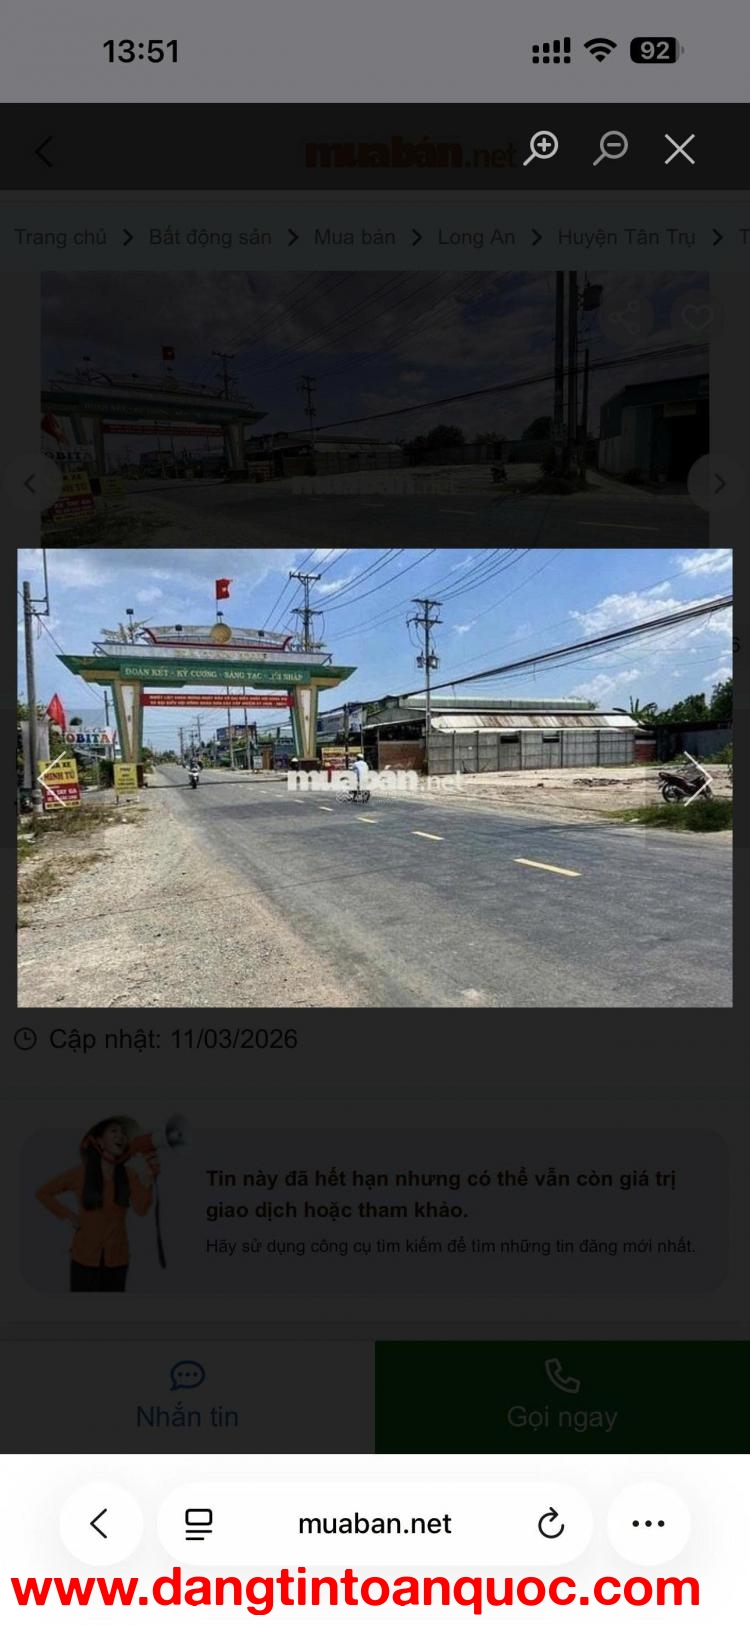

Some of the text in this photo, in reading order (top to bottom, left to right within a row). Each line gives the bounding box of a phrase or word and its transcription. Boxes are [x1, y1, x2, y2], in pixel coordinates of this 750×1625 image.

[103, 39, 179, 63] 13:51
[640, 41, 670, 60] 92
[14, 228, 106, 248] Trang chủ
[150, 225, 271, 248] Bất động sản
[315, 228, 395, 245] Mua bán
[439, 229, 515, 248] Long An
[558, 225, 695, 248] Huyện Tân Trụ
[49, 1028, 298, 1054] Cập nhật: 11/03/2026
[206, 1166, 676, 1190] Tin này đã hết hạn nhưng có thể vẫn còn giá trị
[206, 1200, 468, 1222] giao dịch hoặc tham khảo.
[206, 1236, 696, 1256] Hãy sử dụng công cụ tìm kiếm để tìm những tin đăng mới nhất.
[136, 1400, 239, 1428] Nhắn tin
[507, 1406, 618, 1433] Gọi ngay
[298, 1511, 452, 1535] muaban.net
